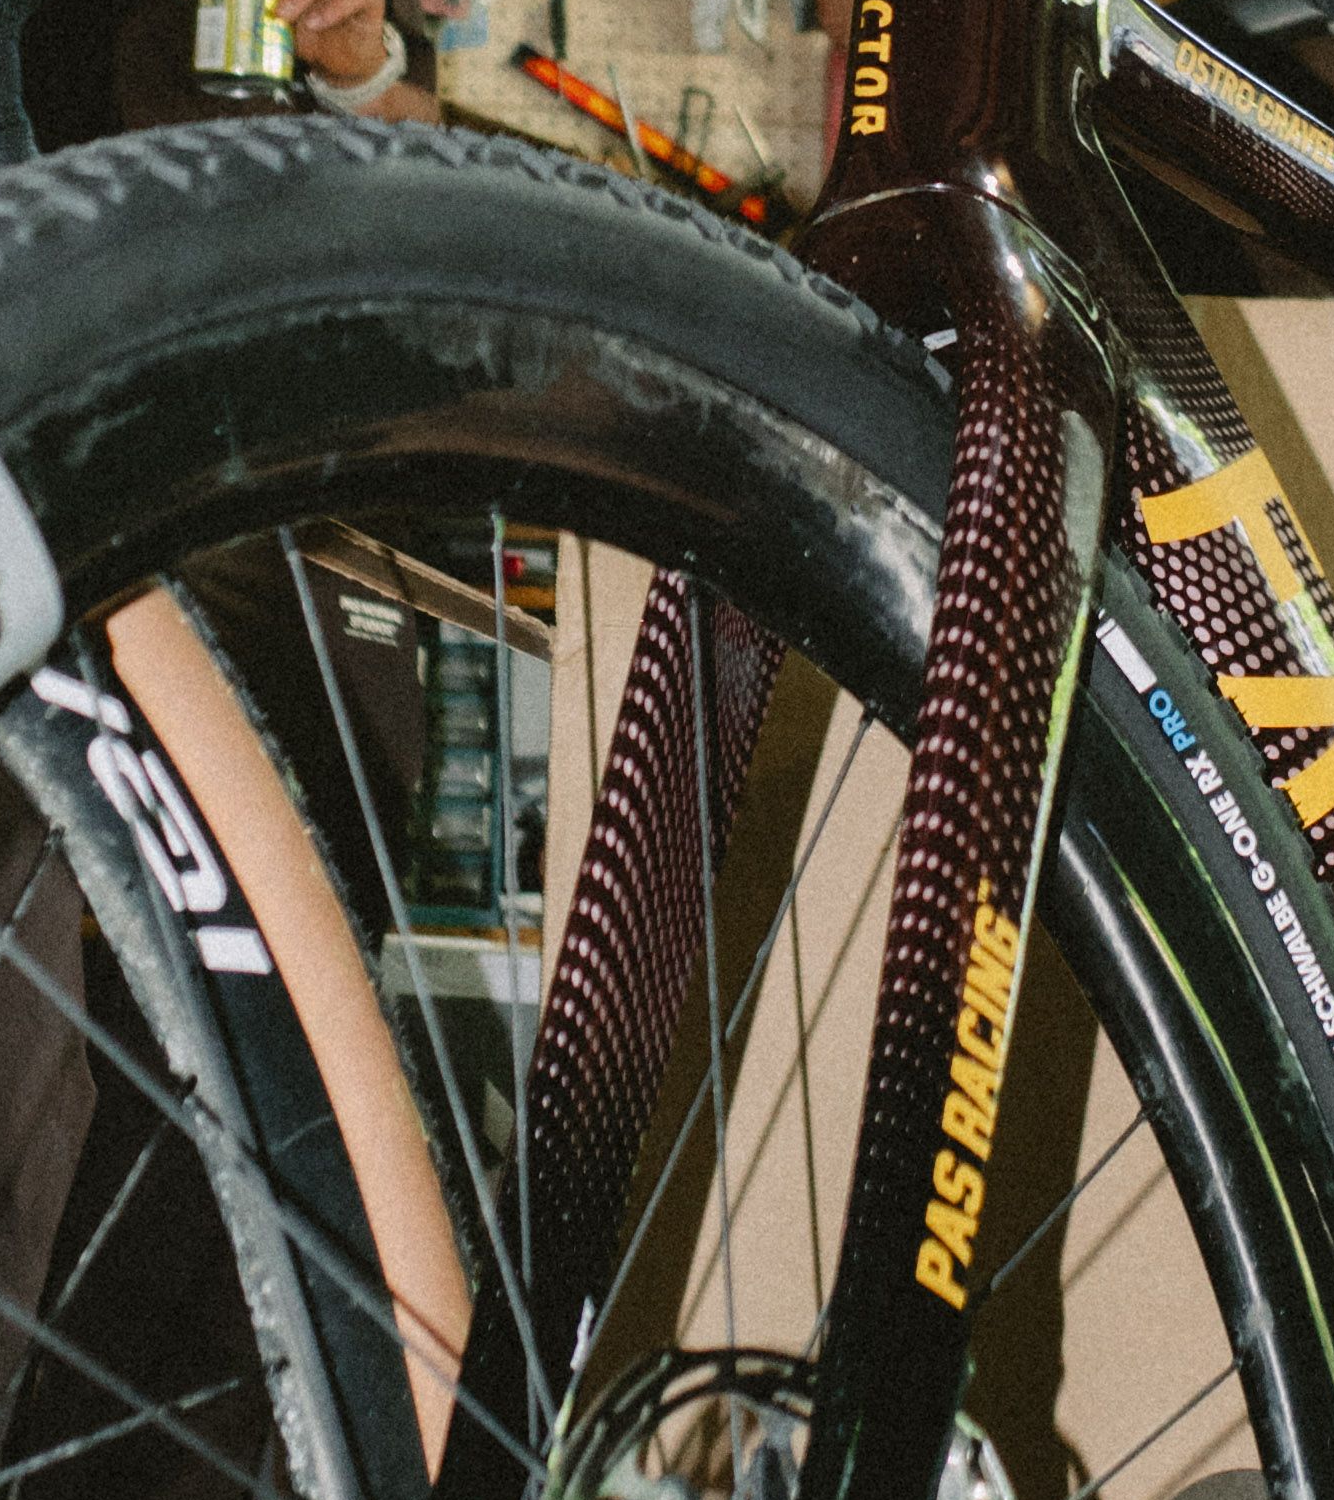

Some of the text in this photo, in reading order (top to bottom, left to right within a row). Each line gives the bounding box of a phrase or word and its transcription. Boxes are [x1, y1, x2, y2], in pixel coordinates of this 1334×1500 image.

[1148, 689, 1196, 753] PRO
[1184, 749, 1223, 795] RX
[1209, 789, 1276, 892] G-ONE
[915, 1148, 986, 1311] PAS
